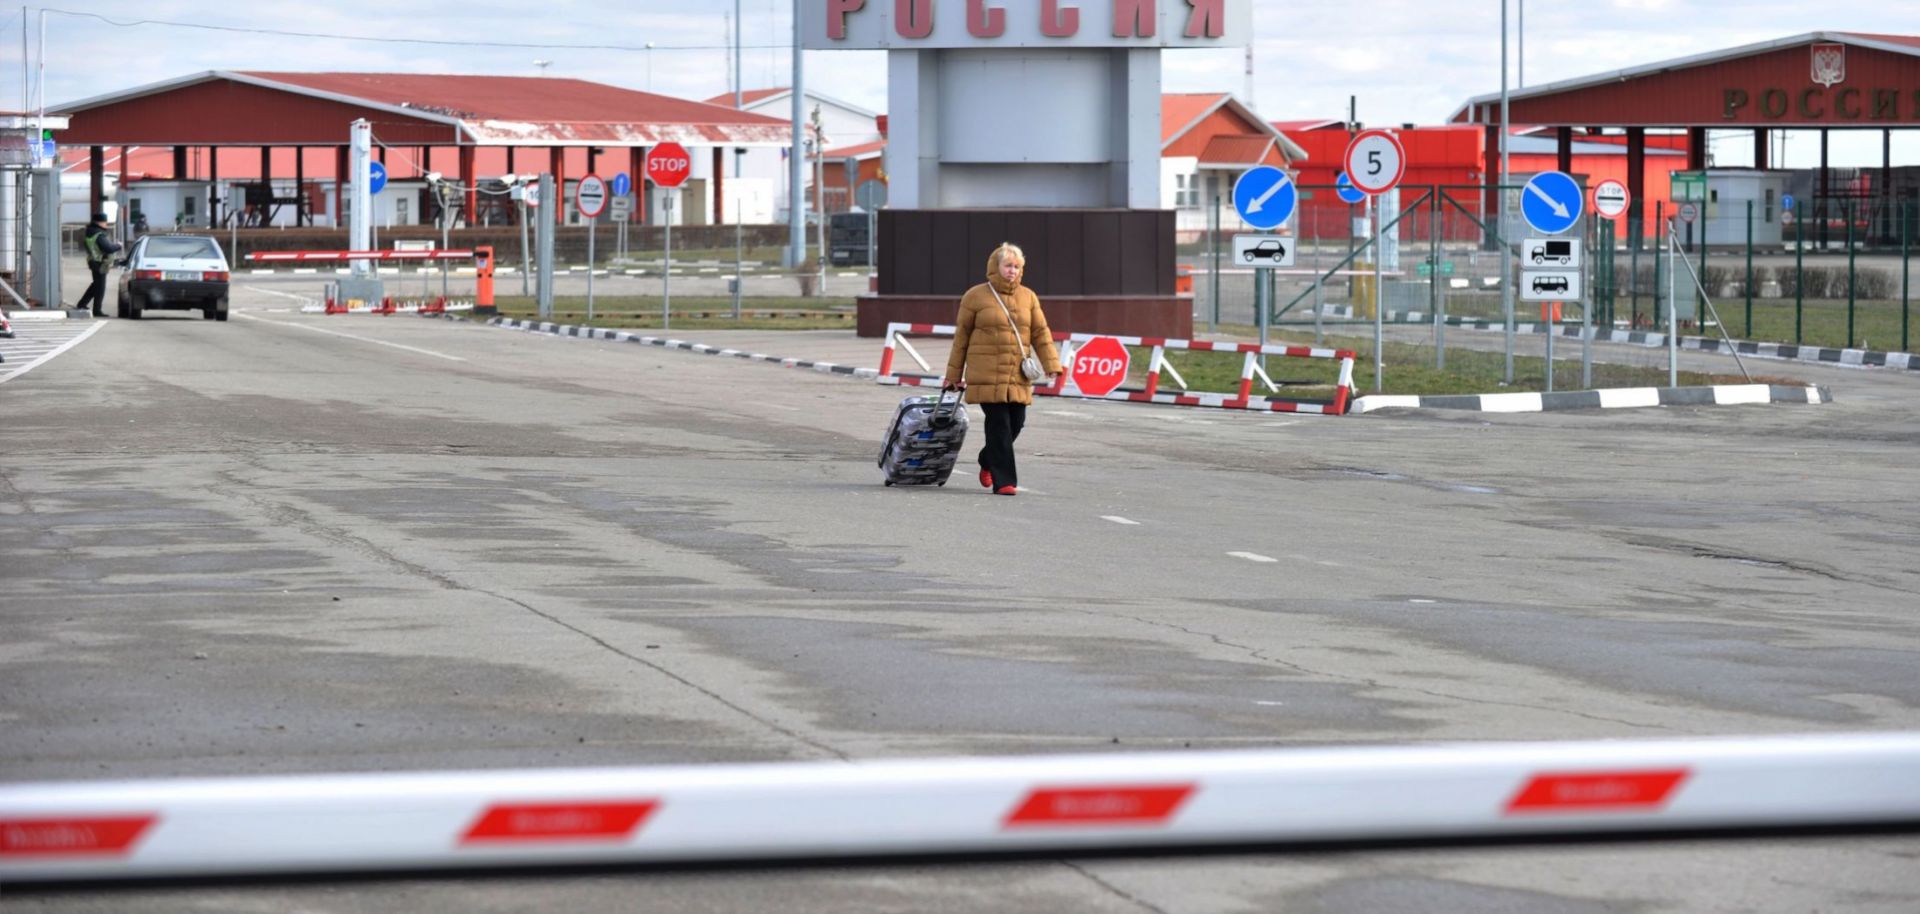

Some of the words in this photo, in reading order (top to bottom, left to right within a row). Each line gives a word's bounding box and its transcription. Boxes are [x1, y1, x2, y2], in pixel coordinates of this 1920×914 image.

[650, 157, 688, 172] STOP
[1367, 150, 1382, 176] 5
[583, 183, 600, 192] STOP
[1599, 186, 1622, 196] STOP
[1076, 356, 1123, 377] STOP
